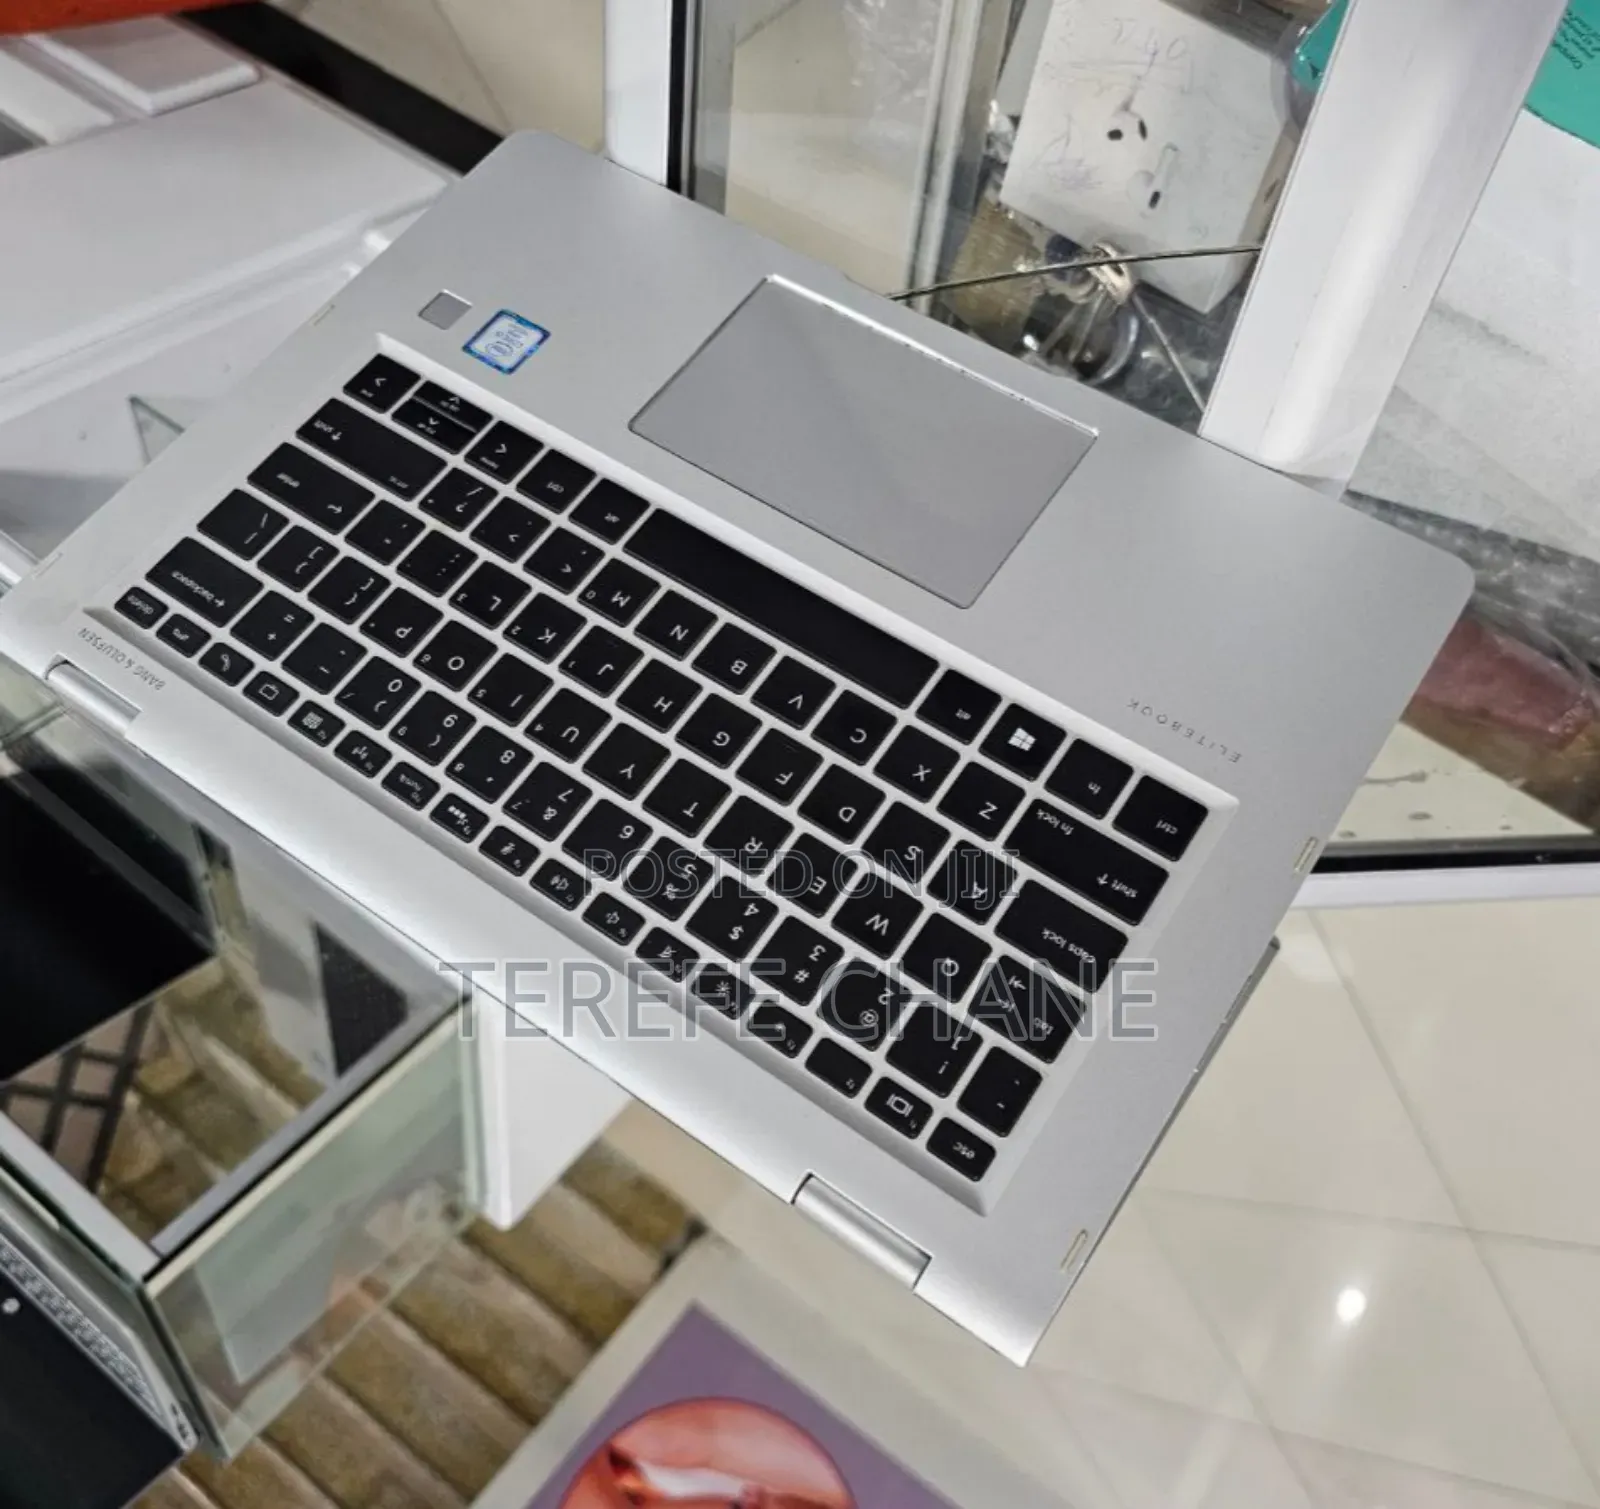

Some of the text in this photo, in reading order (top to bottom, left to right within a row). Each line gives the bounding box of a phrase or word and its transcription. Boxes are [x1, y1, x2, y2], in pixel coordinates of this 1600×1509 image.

[171, 570, 215, 602] backspace
[489, 594, 503, 612] L
[610, 590, 632, 608] M
[283, 613, 295, 623] =
[395, 625, 413, 639] P
[537, 628, 558, 644] K
[669, 624, 689, 641] N
[78, 627, 166, 691] BANG & OLUFSEN
[447, 655, 465, 671] O
[730, 659, 749, 676] B
[596, 663, 615, 676] J
[387, 679, 403, 693] 0
[509, 694, 523, 708] I
[653, 696, 674, 713] H
[787, 694, 804, 711] V
[442, 714, 459, 728] 9
[955, 708, 972, 721] alt
[560, 725, 580, 743] U
[712, 731, 731, 747] G
[849, 727, 868, 744] C
[1124, 698, 1243, 763] ELITEBOOK
[500, 749, 516, 764] 8
[619, 763, 636, 780] Y
[774, 771, 794, 786] F
[912, 764, 932, 782] X
[557, 788, 574, 802] 7
[1087, 781, 1101, 795] fn
[542, 806, 558, 821] &
[682, 801, 699, 818] T
[838, 806, 857, 823] D
[978, 801, 998, 820] Z
[1036, 808, 1075, 836] fn lock
[1155, 819, 1178, 835] ctrl
[617, 824, 635, 839] 6
[744, 836, 763, 855] R
[903, 845, 922, 861] S
[809, 875, 828, 895] E
[971, 881, 989, 900] A
[1111, 879, 1139, 898] shift
[743, 902, 760, 917] 4
[728, 924, 745, 941] $
[864, 913, 890, 937] W
[808, 944, 827, 962] 3
[1041, 927, 1096, 963] caps lock
[941, 957, 959, 977] Q
[793, 968, 810, 984] #
[878, 987, 896, 1006] 2
[859, 1008, 880, 1027] @
[952, 1141, 976, 1160] esc
